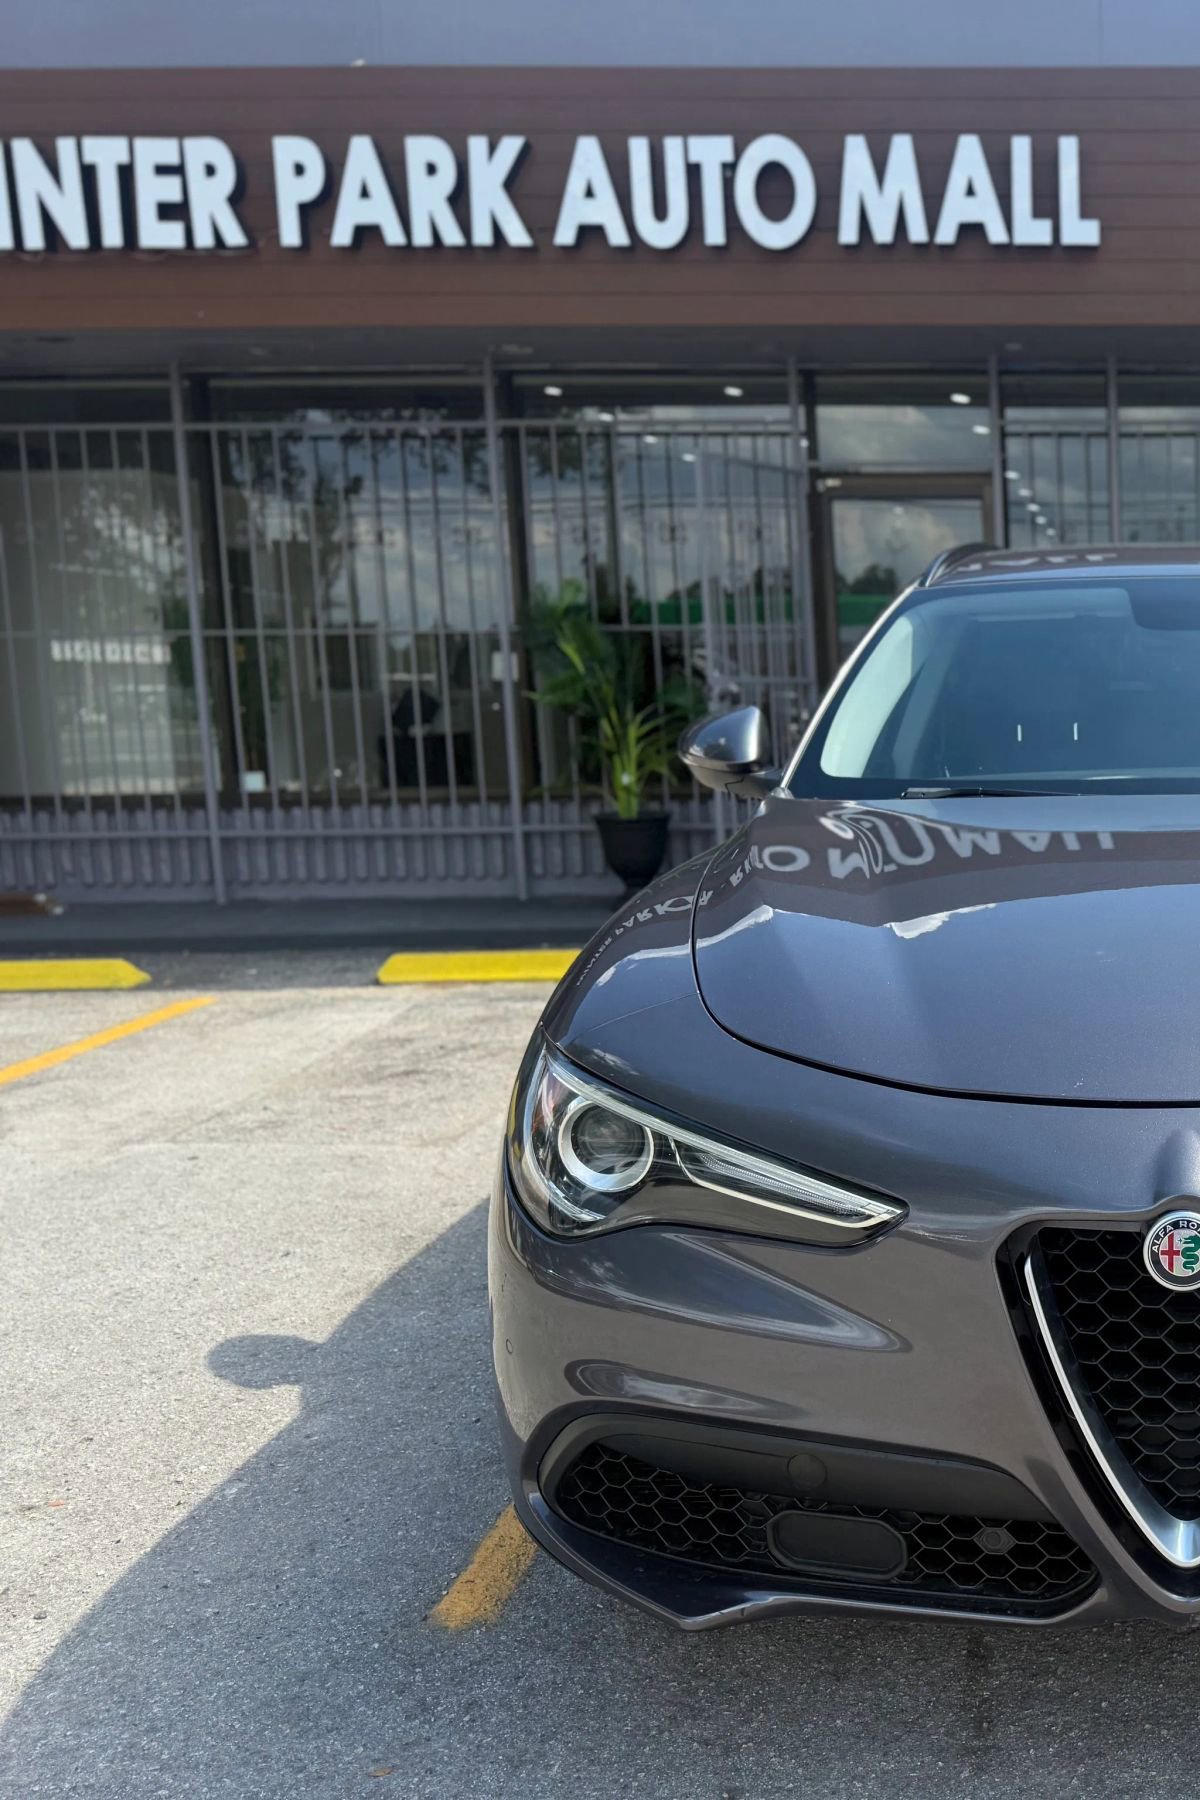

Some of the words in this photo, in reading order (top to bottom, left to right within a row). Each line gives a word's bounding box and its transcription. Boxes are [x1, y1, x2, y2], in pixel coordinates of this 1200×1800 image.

[271, 134, 533, 247] PARK
[553, 133, 816, 250] AUTO
[838, 133, 1101, 246] MALL
[1151, 1224, 1175, 1254] ALFA
